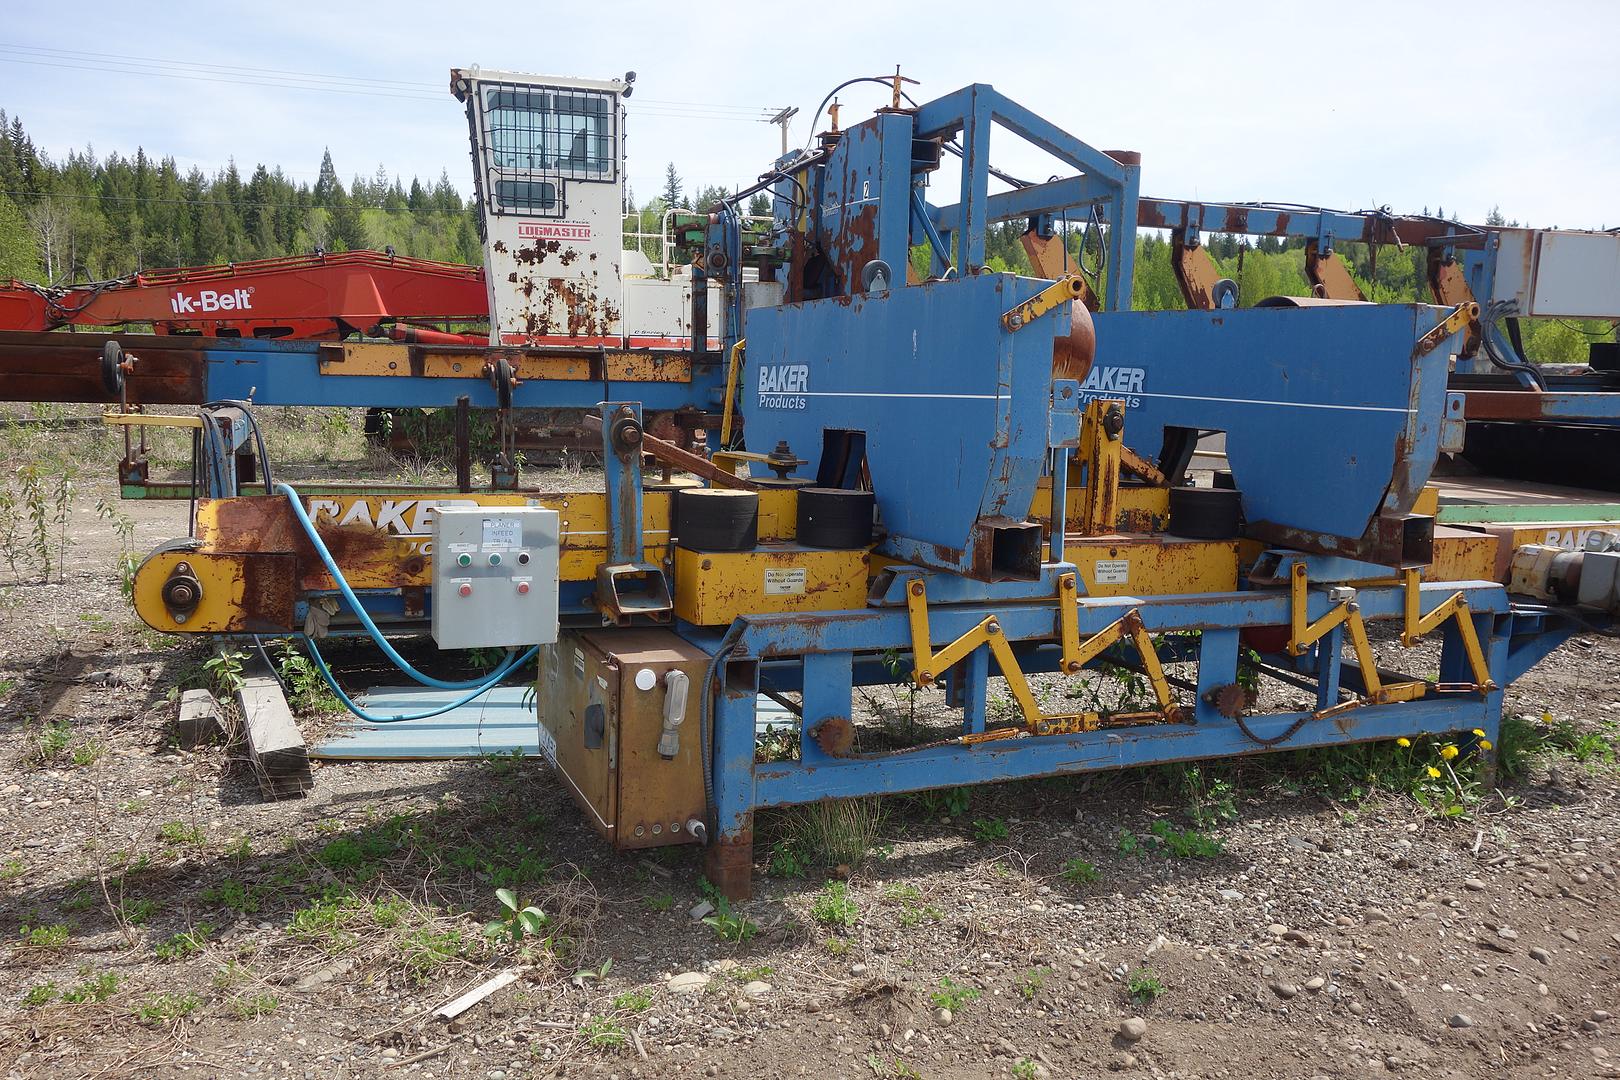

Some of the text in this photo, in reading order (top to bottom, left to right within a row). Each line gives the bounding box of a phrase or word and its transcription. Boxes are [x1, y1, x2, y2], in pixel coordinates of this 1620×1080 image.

[864, 182, 869, 199] 2
[518, 226, 591, 238] LOGMASTER
[758, 364, 809, 392] BAKER
[1079, 366, 1146, 393] AKER
[759, 394, 807, 409] Products
[1078, 391, 1141, 408] Prots
[308, 499, 480, 536] BAKE
